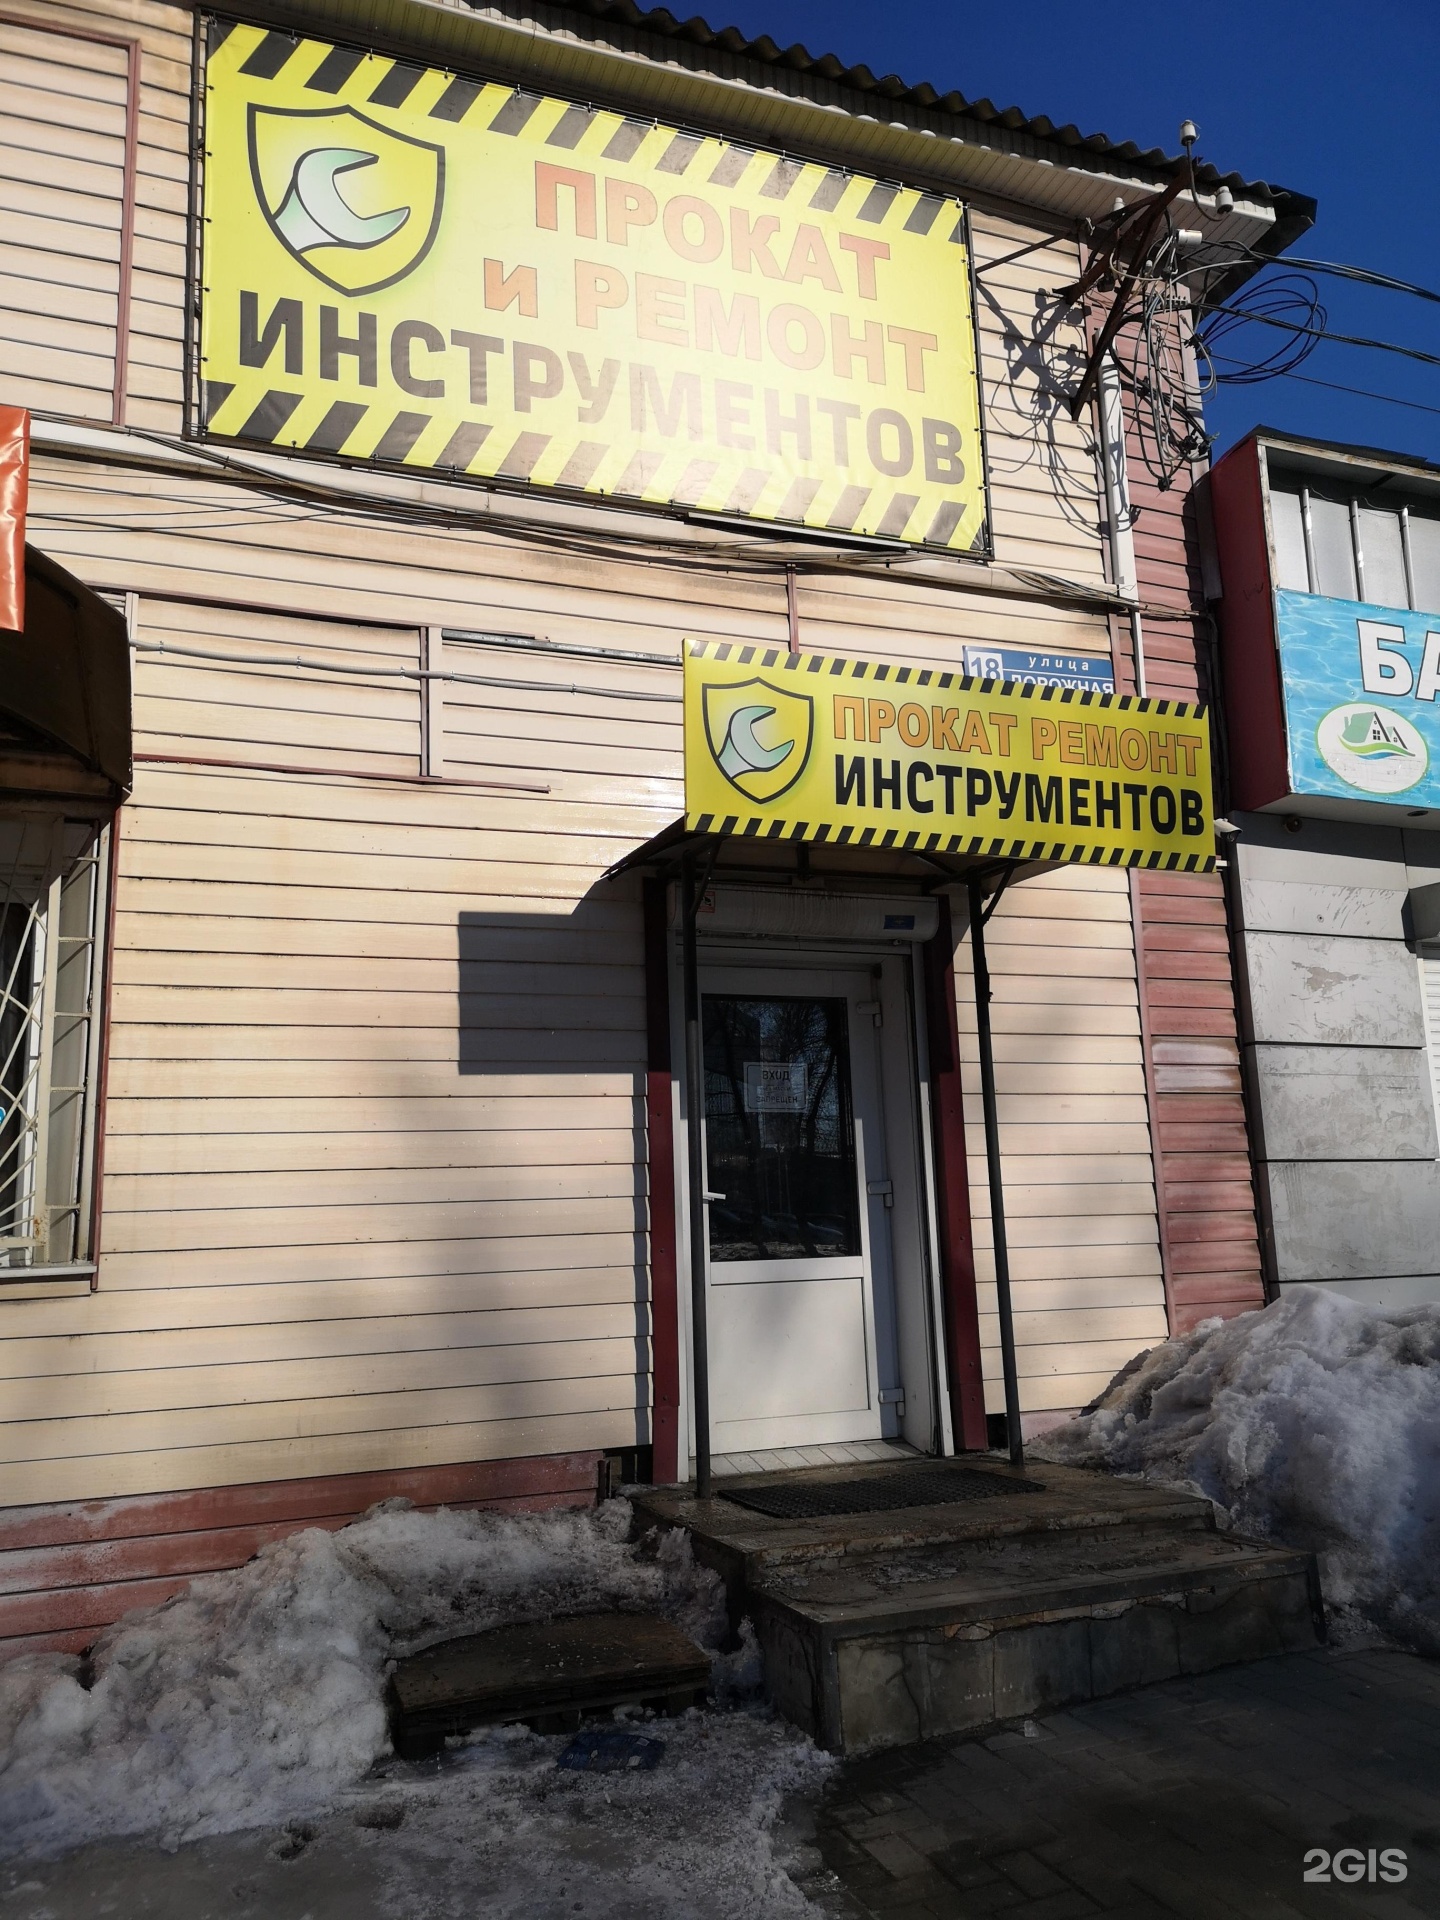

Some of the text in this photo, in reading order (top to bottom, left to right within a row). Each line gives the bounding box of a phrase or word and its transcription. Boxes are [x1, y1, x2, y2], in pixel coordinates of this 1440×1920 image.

[534, 160, 891, 301] ПРОКАТ
[574, 258, 939, 393] РЕМОНТ
[239, 289, 966, 486] ИНСТРУМЕНТОВ
[971, 657, 1000, 680] 18
[1028, 656, 1089, 672] улица
[832, 693, 1203, 776] ПРОКАТ РЕМОНТ
[835, 753, 1206, 837] ИНСТРУМЕНТОВ
[762, 1070, 790, 1081] ВХОД
